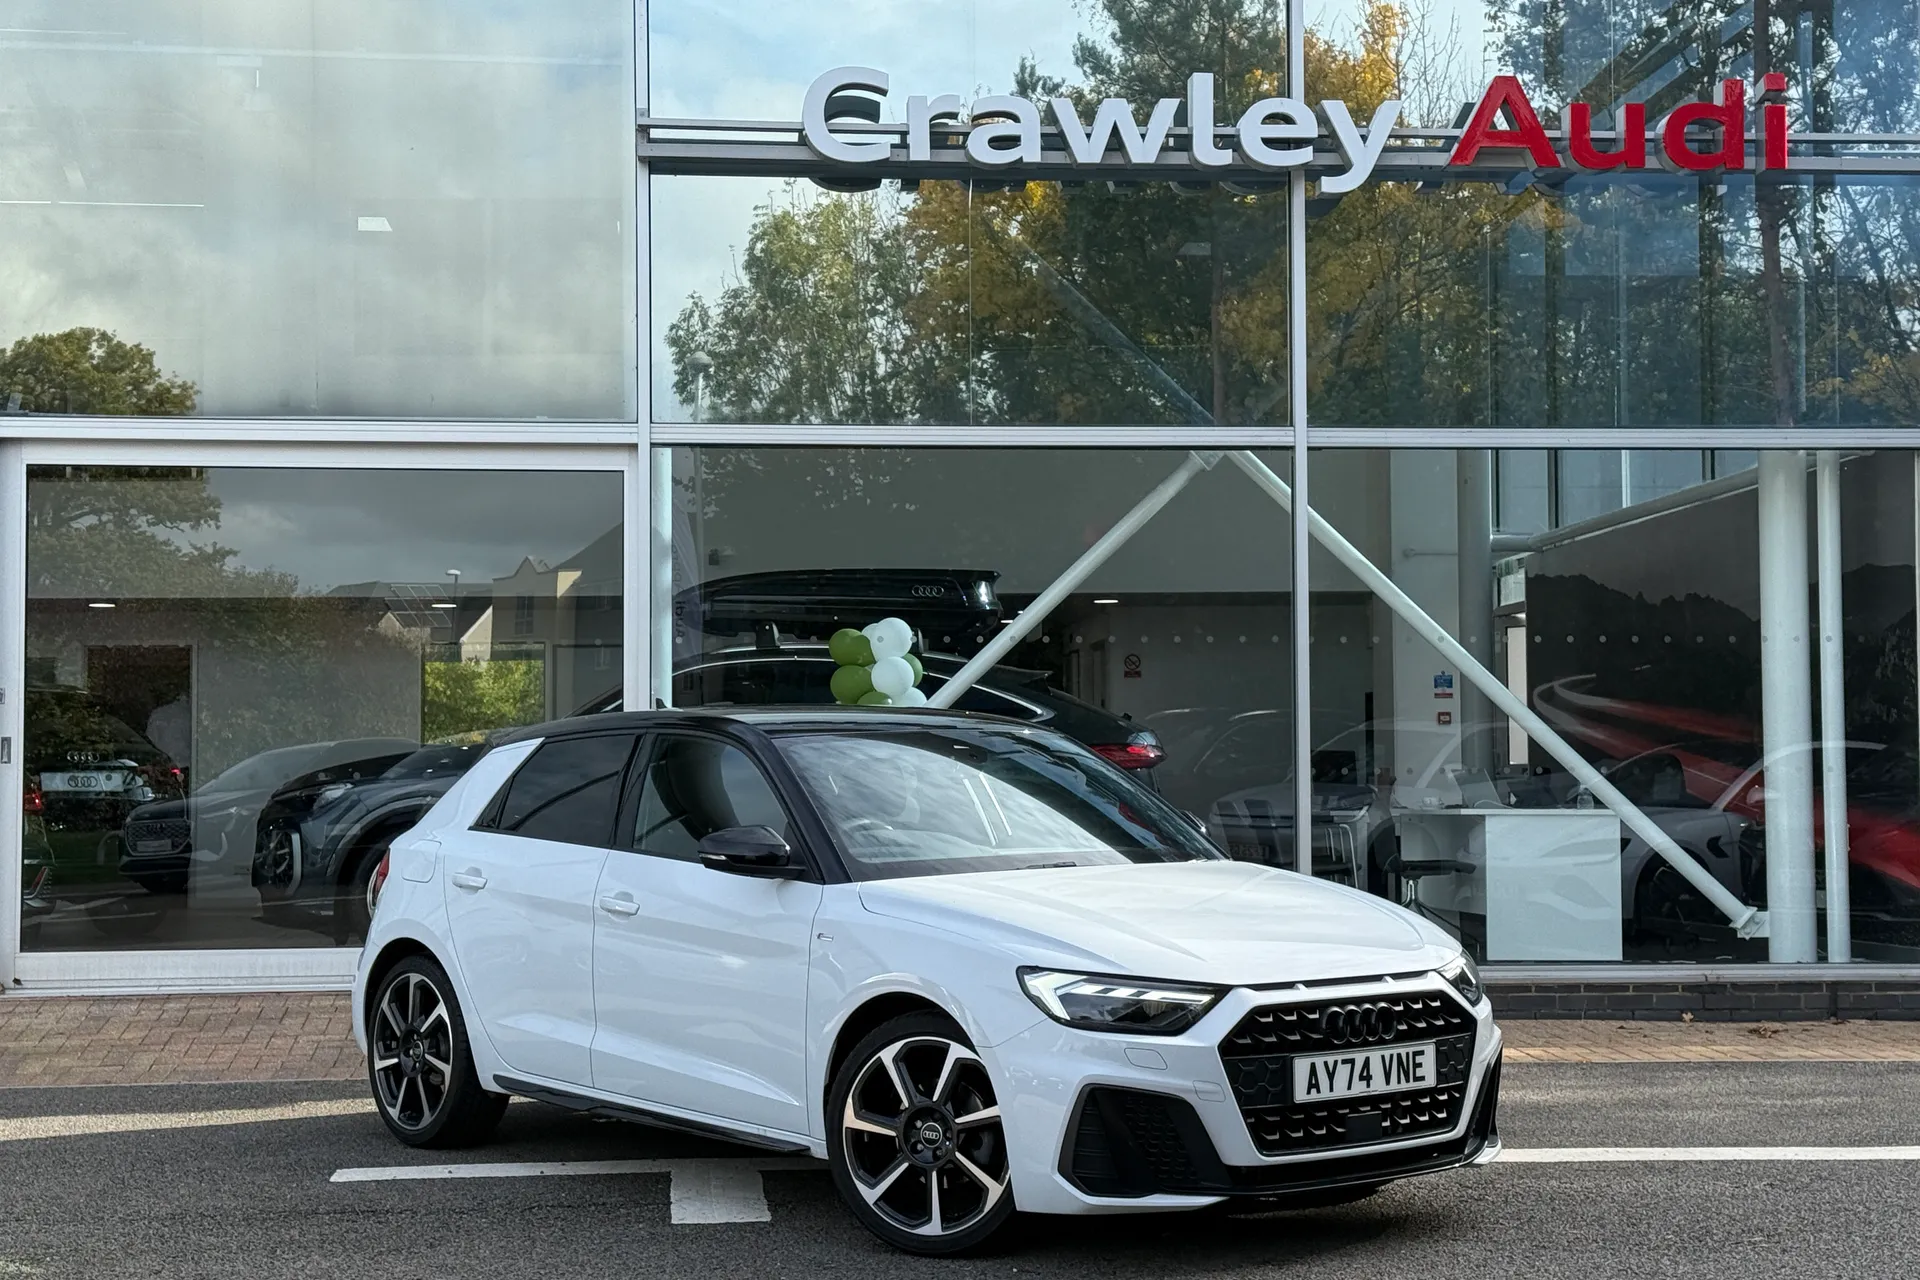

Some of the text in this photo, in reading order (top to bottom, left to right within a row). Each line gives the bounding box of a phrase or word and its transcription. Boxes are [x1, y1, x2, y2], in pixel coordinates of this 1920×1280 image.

[802, 66, 1788, 194] Crawley Audi
[1306, 1050, 1426, 1095] AY74 VNE
